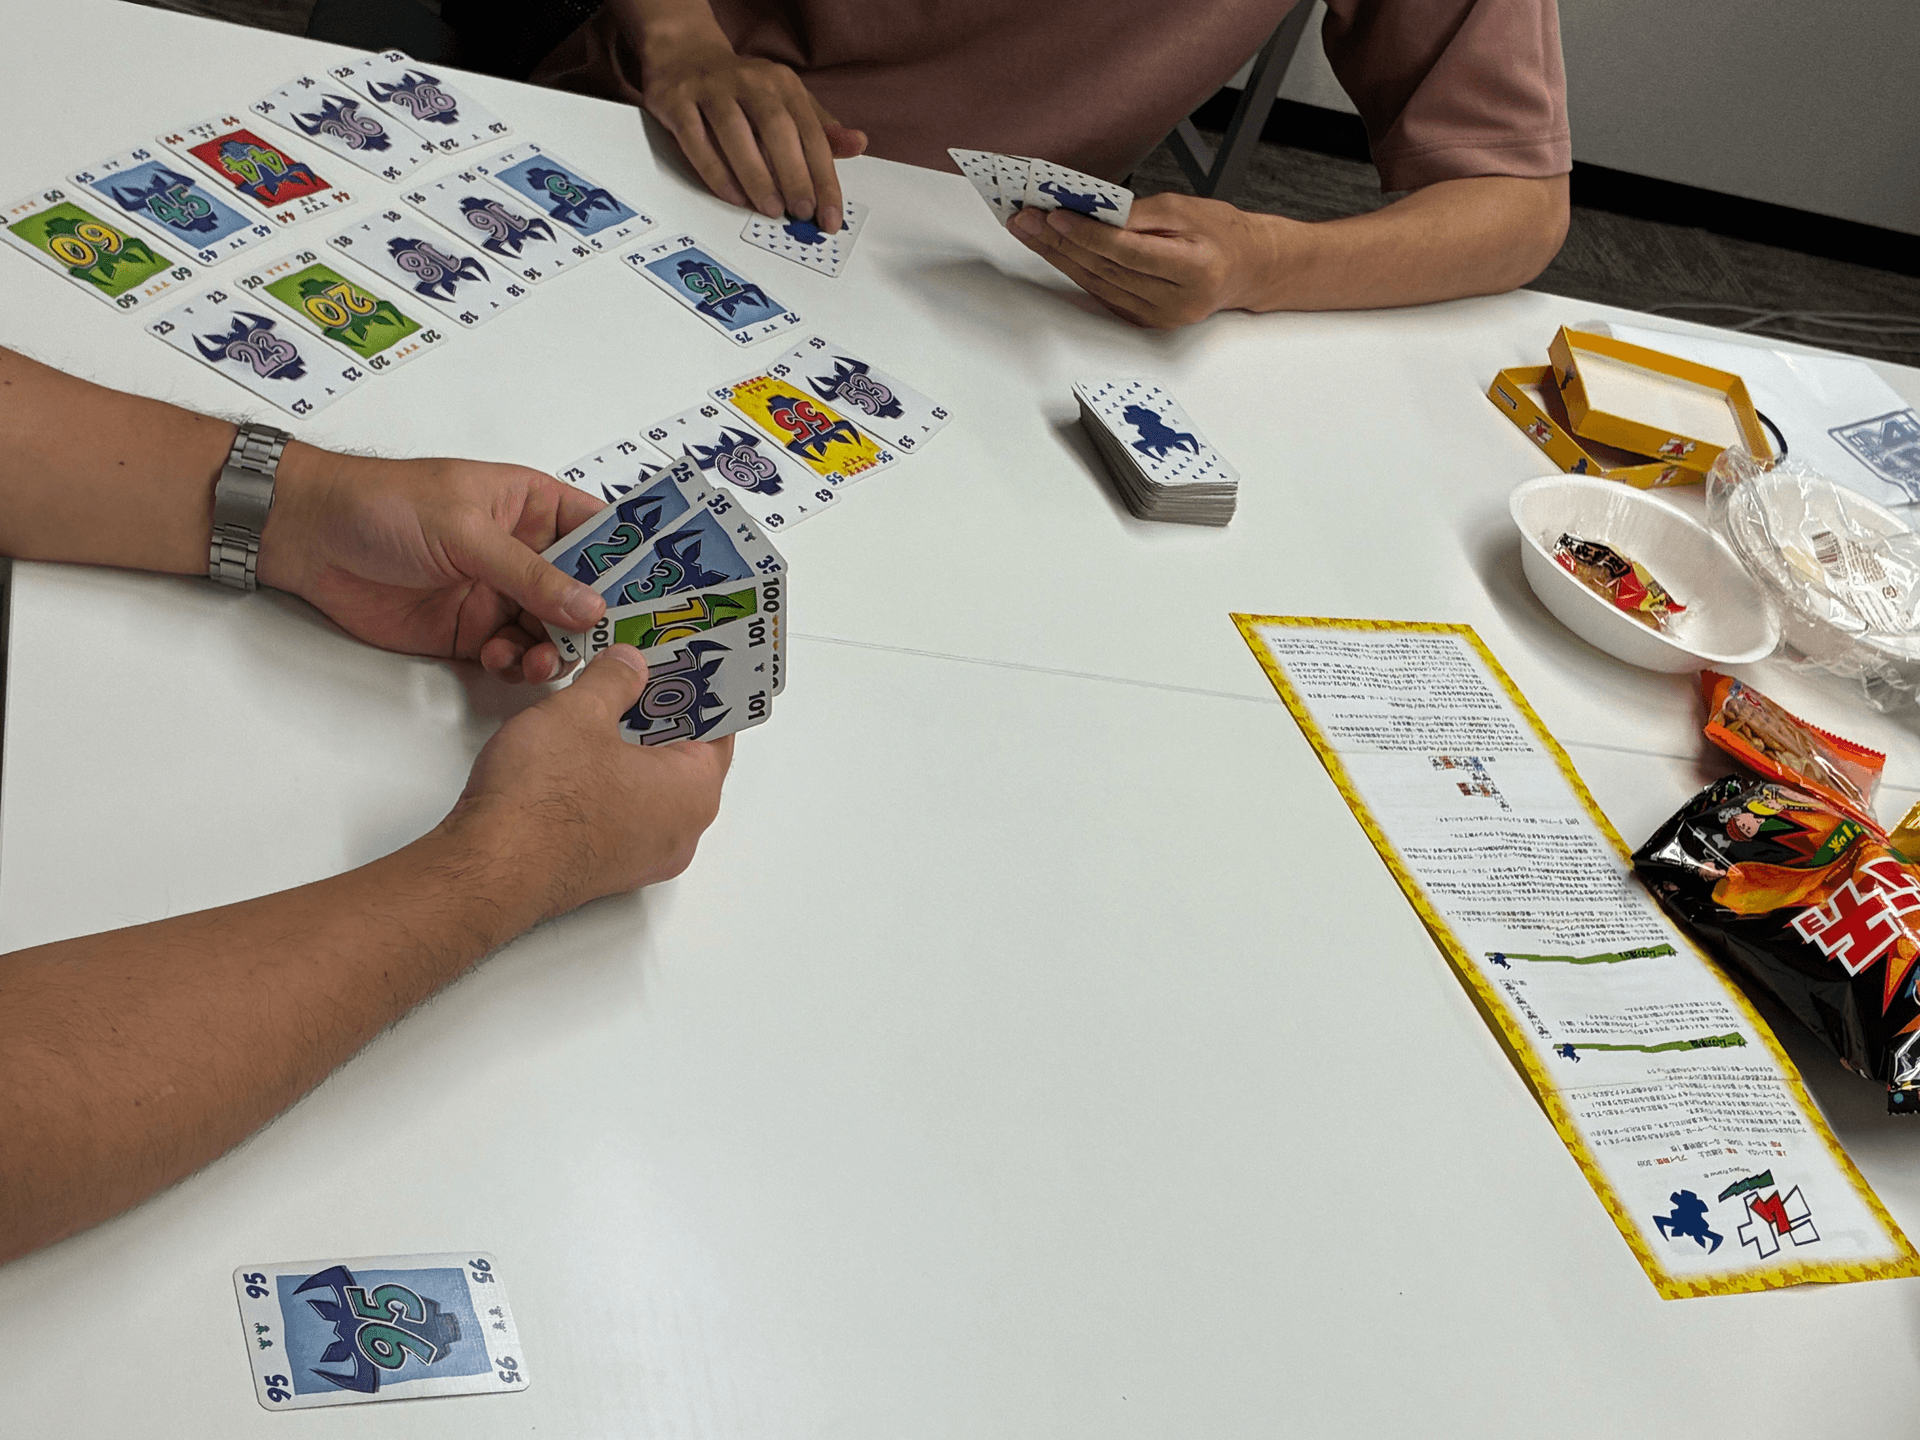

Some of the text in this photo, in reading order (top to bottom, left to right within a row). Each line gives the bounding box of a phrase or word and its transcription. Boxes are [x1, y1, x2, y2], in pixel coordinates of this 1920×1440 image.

[390, 83, 457, 121] 28
[221, 116, 240, 127] 44
[320, 106, 384, 150] 36
[488, 122, 507, 134] 28
[165, 134, 184, 145] 44
[439, 138, 459, 151] 28
[131, 149, 151, 161] 45
[529, 143, 541, 153] 5
[221, 147, 288, 185] 44
[382, 166, 402, 180] 36
[477, 166, 489, 175] 5
[75, 172, 95, 184] 45
[458, 171, 477, 183] 16
[332, 191, 350, 203] 44
[545, 174, 587, 205] 5
[146, 183, 212, 227] 45
[407, 192, 427, 204] 16
[276, 212, 296, 223] 44
[382, 210, 402, 223] 18
[466, 200, 531, 241] 16
[640, 214, 653, 225] 5
[252, 224, 273, 238] 45
[48, 221, 123, 269] 60
[333, 234, 353, 248] 18
[591, 238, 603, 249] 5
[677, 235, 696, 248] 75
[199, 249, 219, 262] 45
[296, 251, 318, 265] 20
[571, 245, 591, 258] 16
[627, 252, 646, 266] 75
[396, 241, 463, 283] 18
[172, 266, 192, 281] 60
[522, 268, 543, 282] 16
[242, 275, 265, 290] 20
[683, 266, 744, 305] 75
[207, 290, 228, 304] 23
[506, 283, 526, 298] 18
[116, 294, 139, 309] 60
[304, 282, 376, 327] 20
[460, 311, 480, 325] 18
[783, 312, 801, 325] 75
[153, 320, 176, 335] 23
[420, 328, 442, 344] 20
[735, 331, 753, 345] 75
[809, 337, 827, 350] 53
[227, 329, 298, 378] 23
[368, 355, 391, 370] 20
[342, 366, 363, 382] 23
[773, 363, 791, 378] 53
[714, 388, 735, 401] 55
[837, 373, 893, 417] 53
[291, 398, 314, 415] 23
[700, 405, 720, 419] 63
[930, 406, 949, 421] 53
[773, 400, 835, 443] 55
[648, 427, 669, 441] 63
[617, 441, 639, 456] 73
[898, 434, 916, 450] 53
[874, 450, 894, 465] 55
[564, 467, 586, 482] 73
[670, 462, 695, 484] 25
[715, 446, 779, 493] 63
[825, 472, 845, 486] 55
[815, 489, 835, 503] 63
[707, 493, 733, 516] 35
[764, 513, 786, 529] 63
[762, 578, 781, 613] 100
[592, 617, 610, 652] 100
[749, 617, 766, 648] 101
[640, 648, 697, 746] 101
[748, 690, 766, 720] 101
[468, 1258, 495, 1284] 95
[243, 1271, 267, 1299] 95
[346, 1283, 437, 1370] 95
[495, 1356, 522, 1384] 95
[264, 1374, 292, 1403] 95
